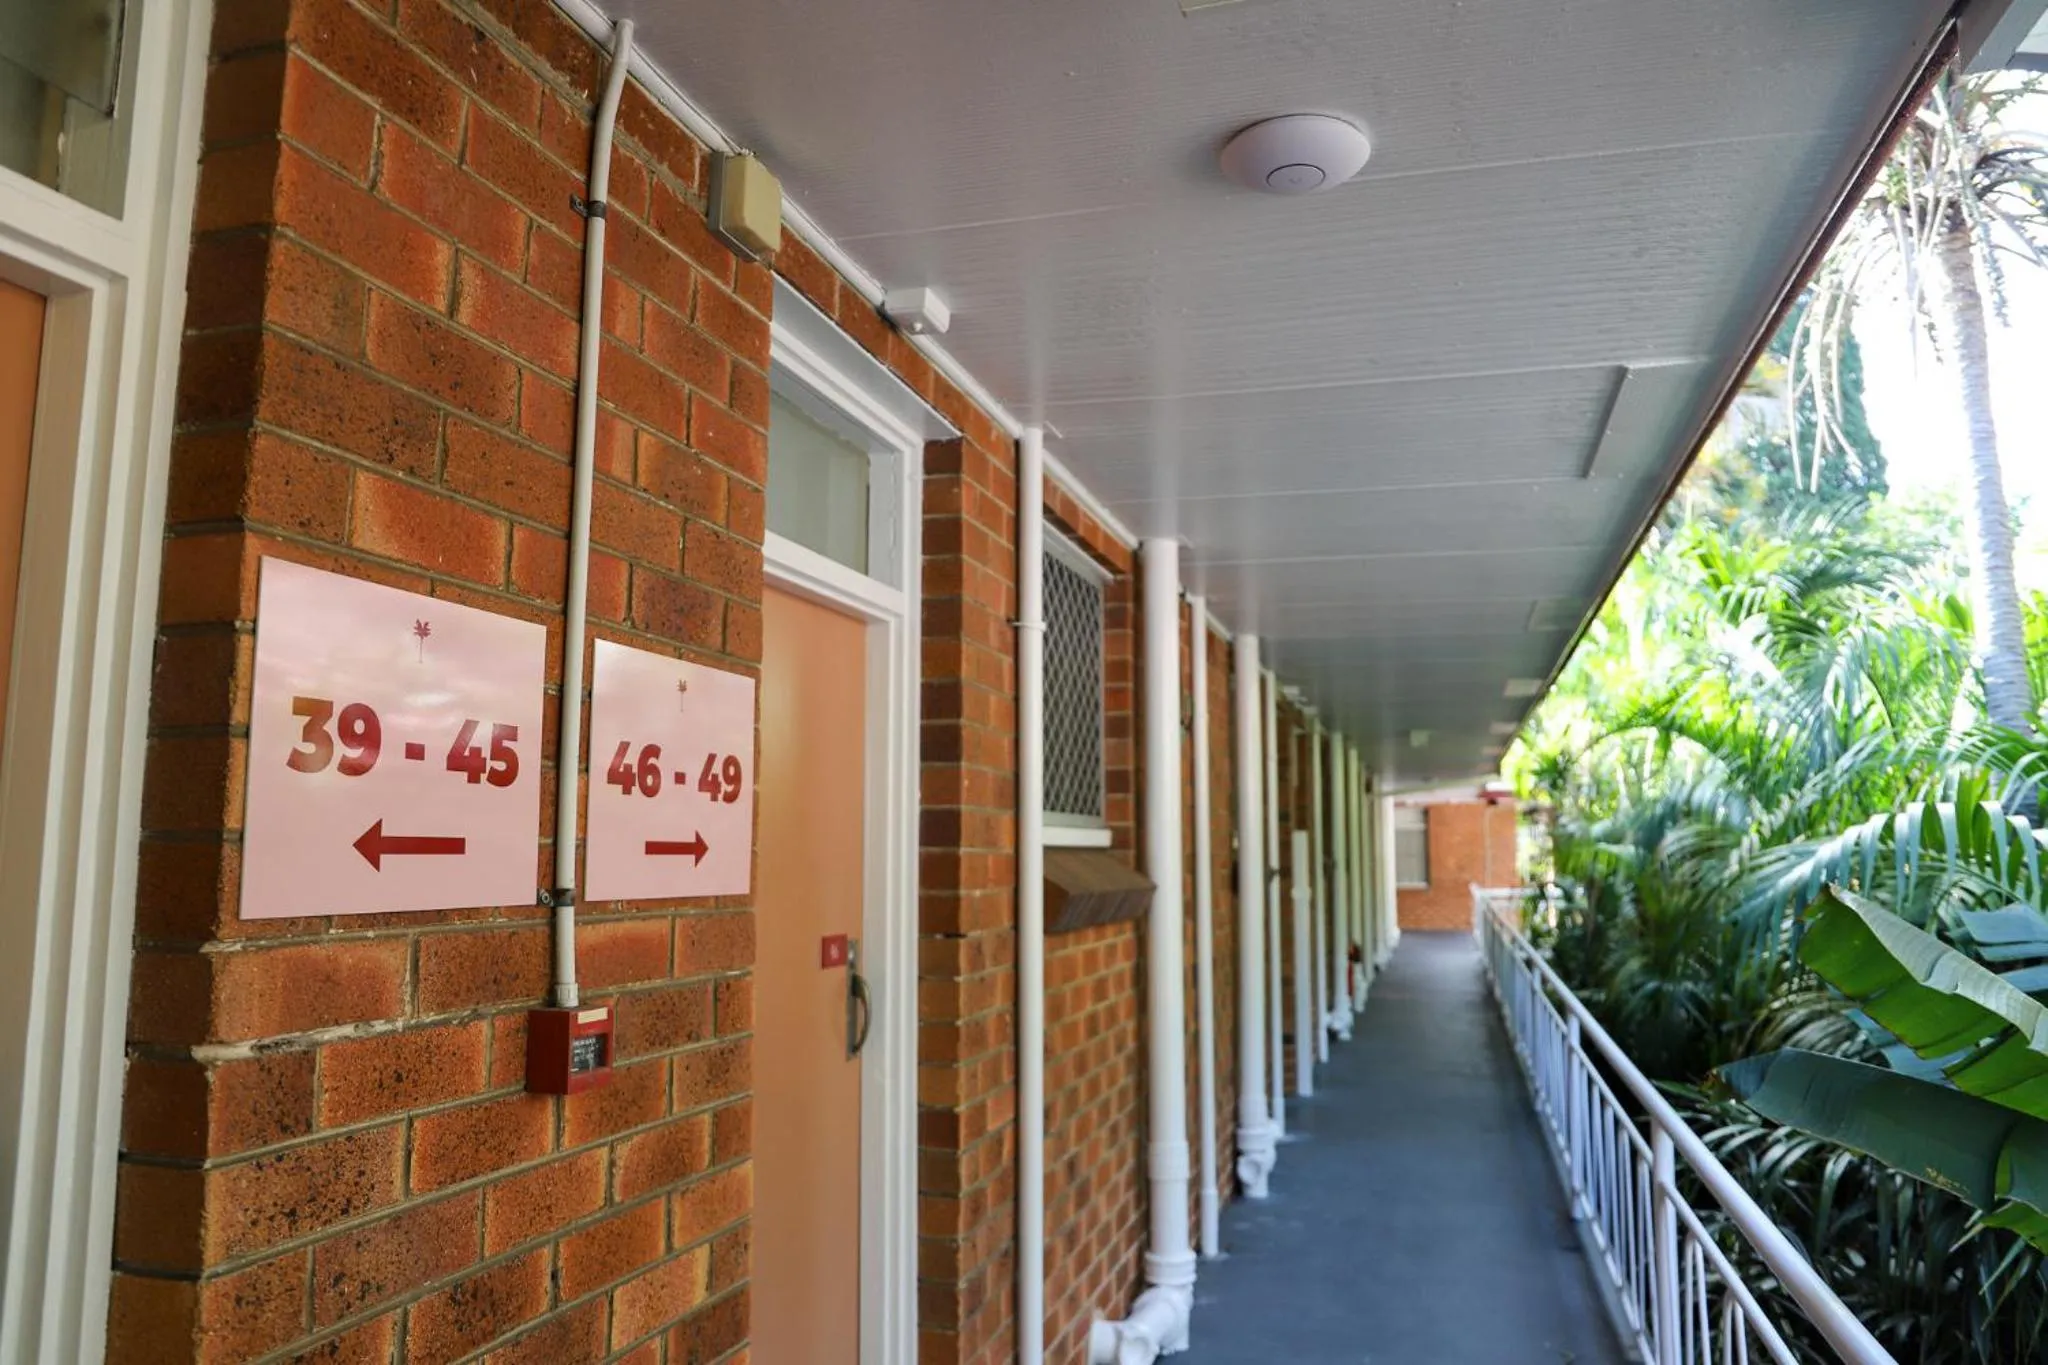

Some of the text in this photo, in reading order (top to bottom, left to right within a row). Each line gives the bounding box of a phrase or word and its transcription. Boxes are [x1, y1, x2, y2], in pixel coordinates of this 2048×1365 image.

[286, 696, 381, 777] 39
[446, 719, 519, 787] 45
[607, 741, 662, 798] 46
[698, 753, 742, 804] 49
